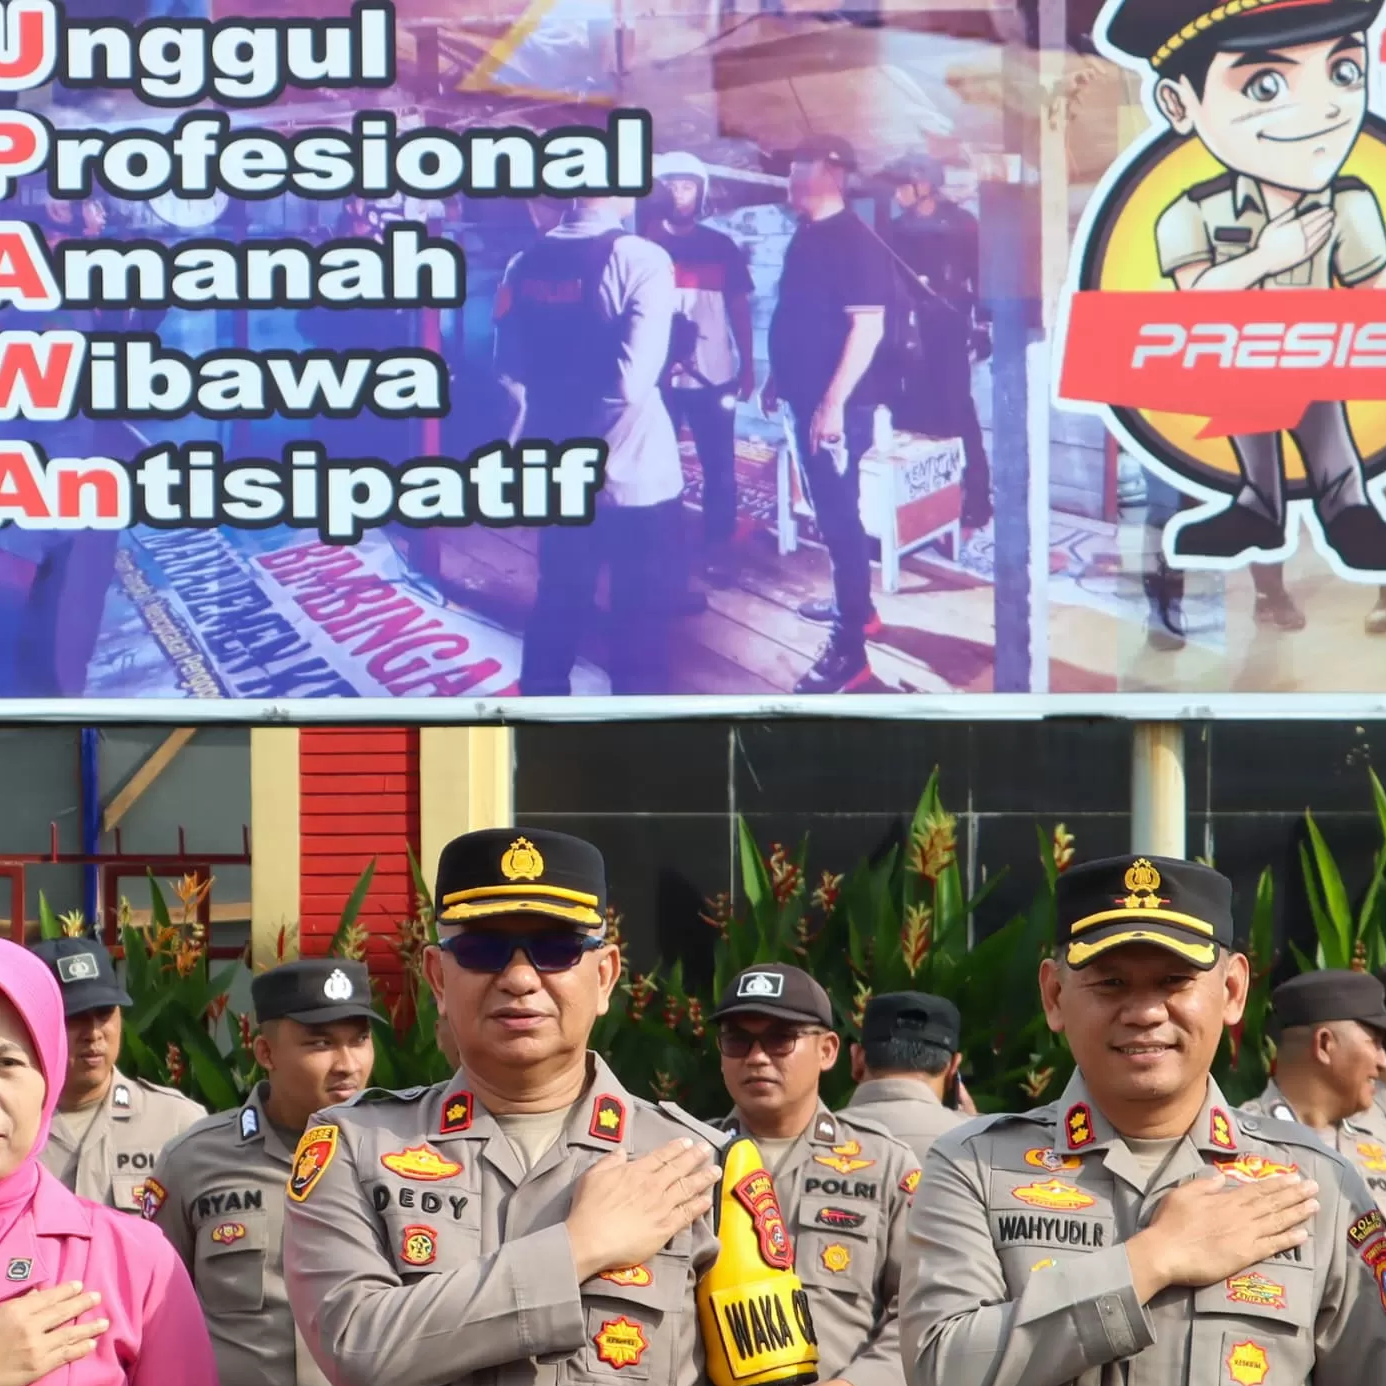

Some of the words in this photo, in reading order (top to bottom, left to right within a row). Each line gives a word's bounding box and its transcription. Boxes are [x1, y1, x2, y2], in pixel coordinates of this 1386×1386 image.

[256, 545, 521, 698] BIMBINGA
[198, 1189, 263, 1219] RYAN
[373, 1184, 469, 1220] DEDY
[805, 1178, 877, 1200] POLRI
[998, 1215, 1104, 1248] WAHYUDI.R
[724, 1293, 795, 1361] WAKA
